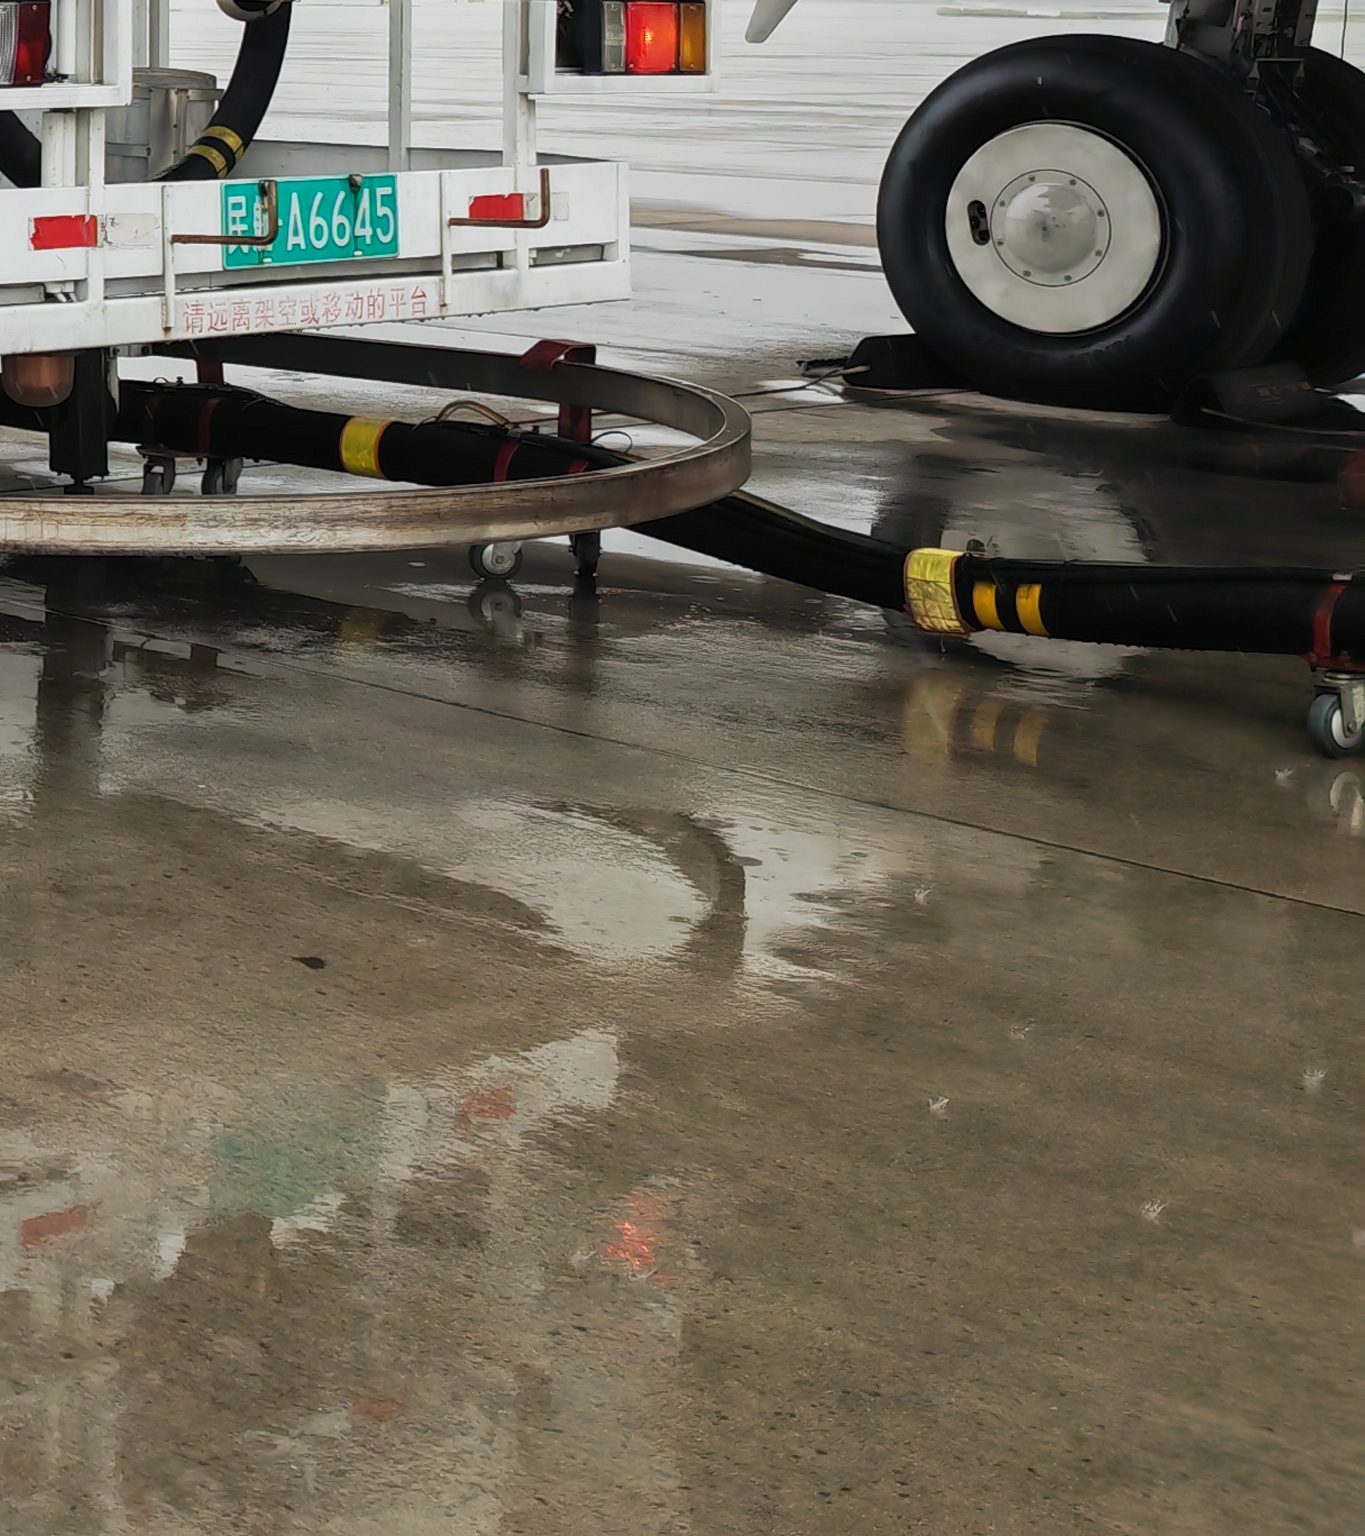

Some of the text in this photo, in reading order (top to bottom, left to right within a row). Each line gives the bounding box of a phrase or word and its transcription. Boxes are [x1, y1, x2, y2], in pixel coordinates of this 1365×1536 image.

[183, 285, 428, 334] 请远离架空或移动的平台
